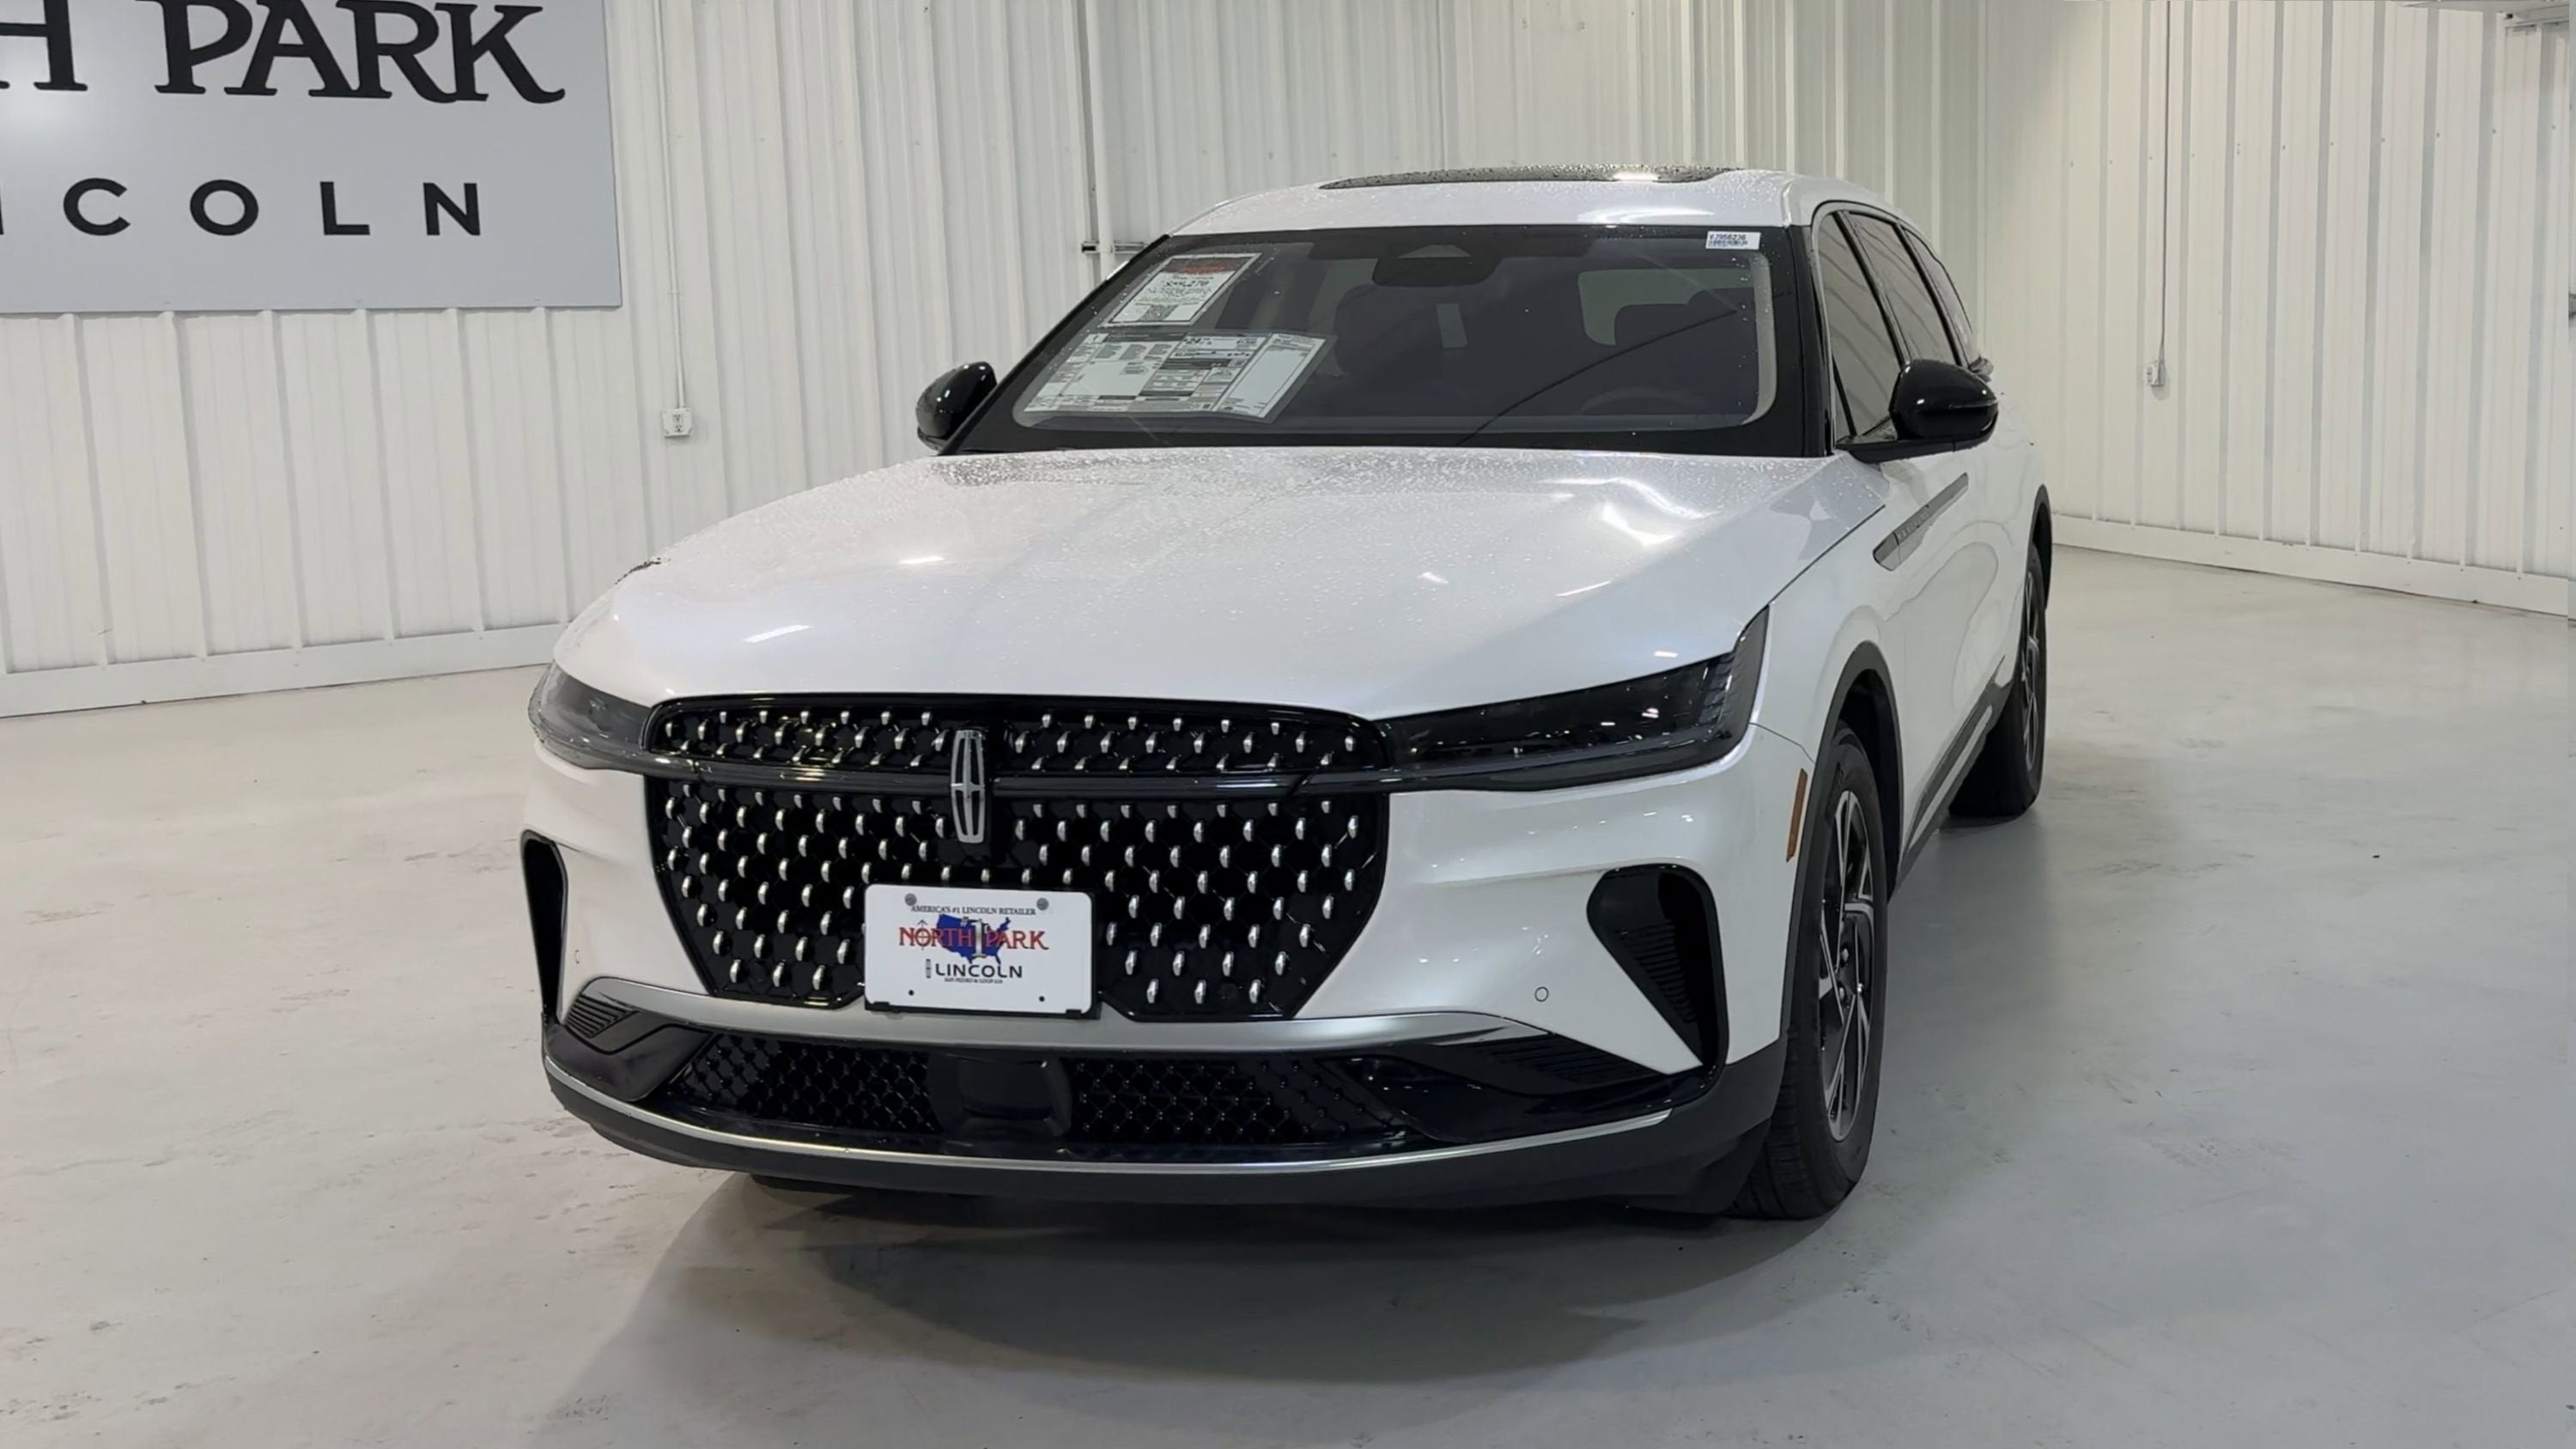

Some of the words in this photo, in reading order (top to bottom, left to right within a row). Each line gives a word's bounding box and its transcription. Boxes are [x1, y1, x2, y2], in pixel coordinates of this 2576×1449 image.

[137, 0, 566, 104] PARK
[0, 177, 482, 236] COLN
[911, 905, 951, 914] AMERICA'S
[962, 906, 998, 915] LINCOLN
[999, 907, 1036, 916] RETAILER
[899, 926, 973, 948] NORTH
[986, 930, 1049, 950] PARK
[935, 963, 1023, 979] LINCOLN
